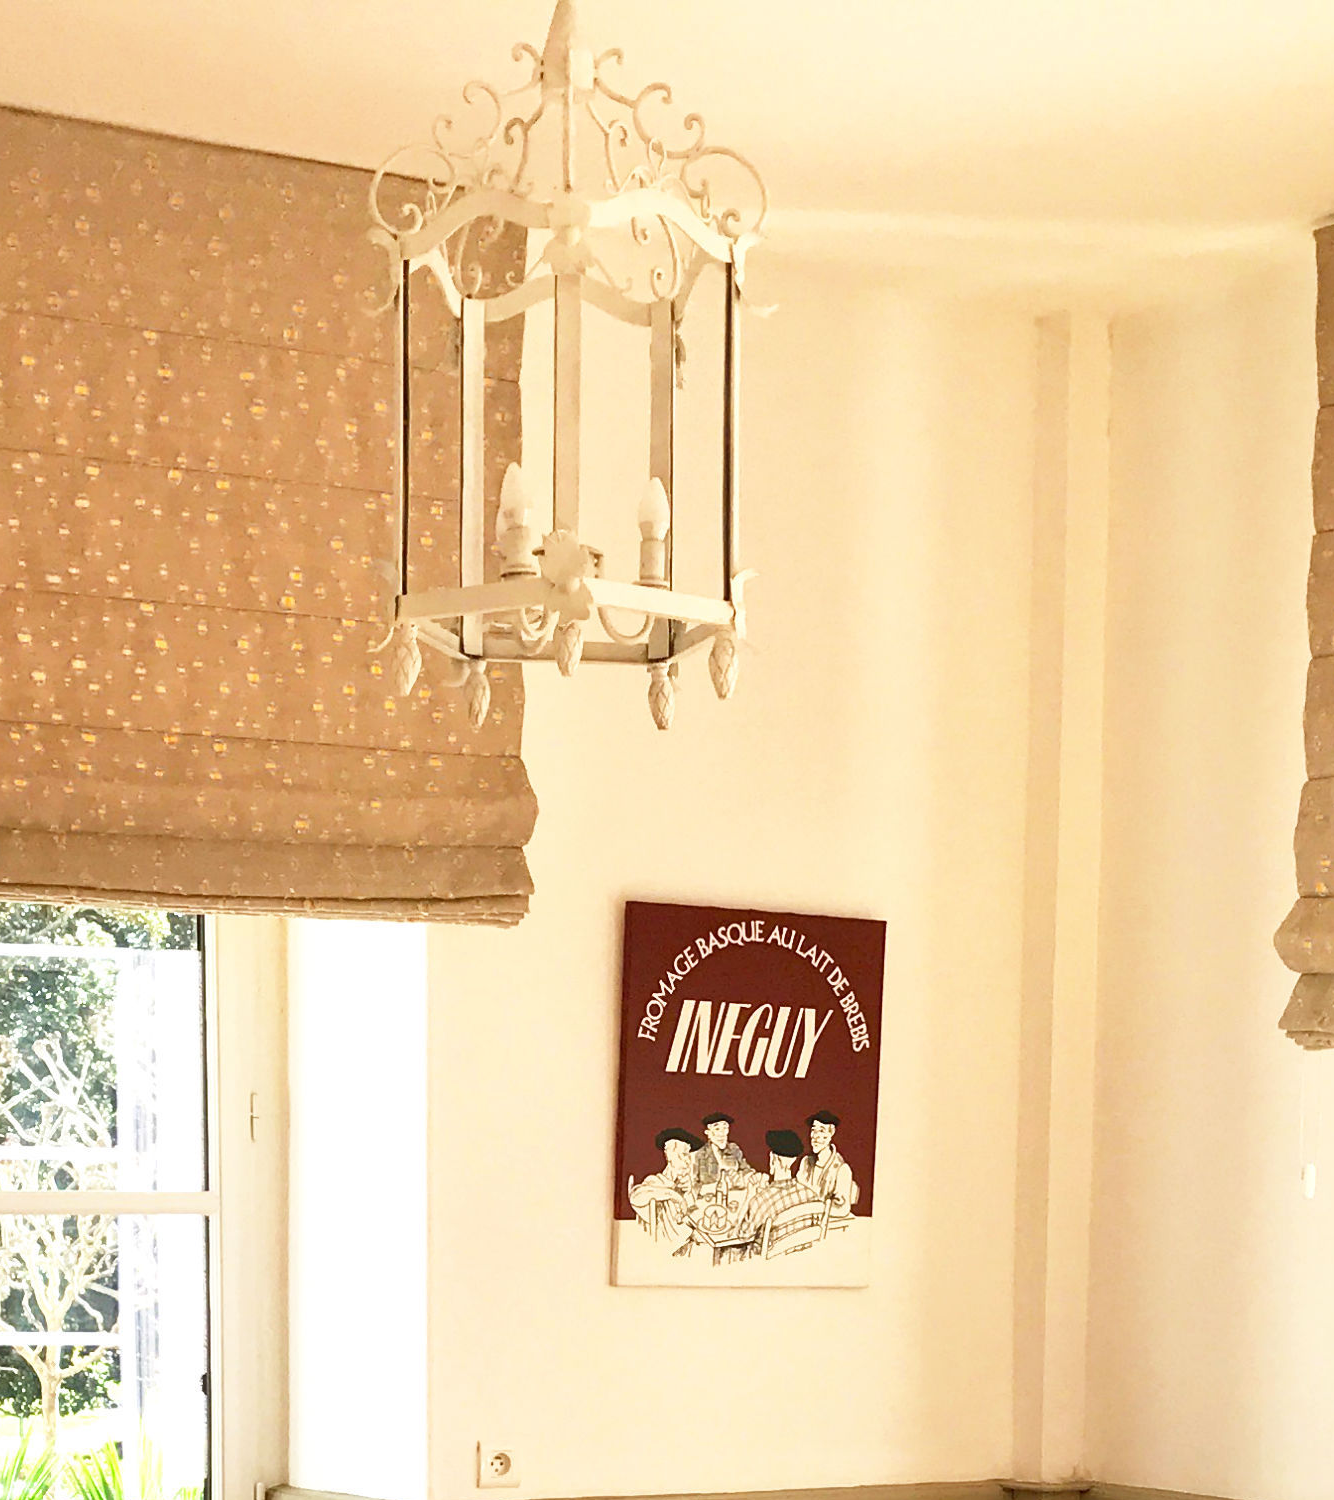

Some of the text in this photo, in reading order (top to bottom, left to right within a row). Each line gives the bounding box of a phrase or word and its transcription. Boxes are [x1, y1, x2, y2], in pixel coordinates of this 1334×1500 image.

[637, 920, 870, 1052] FROMAGE BASQUE AU LAIT DE BREBIS
[665, 999, 834, 1079] INEGUY
